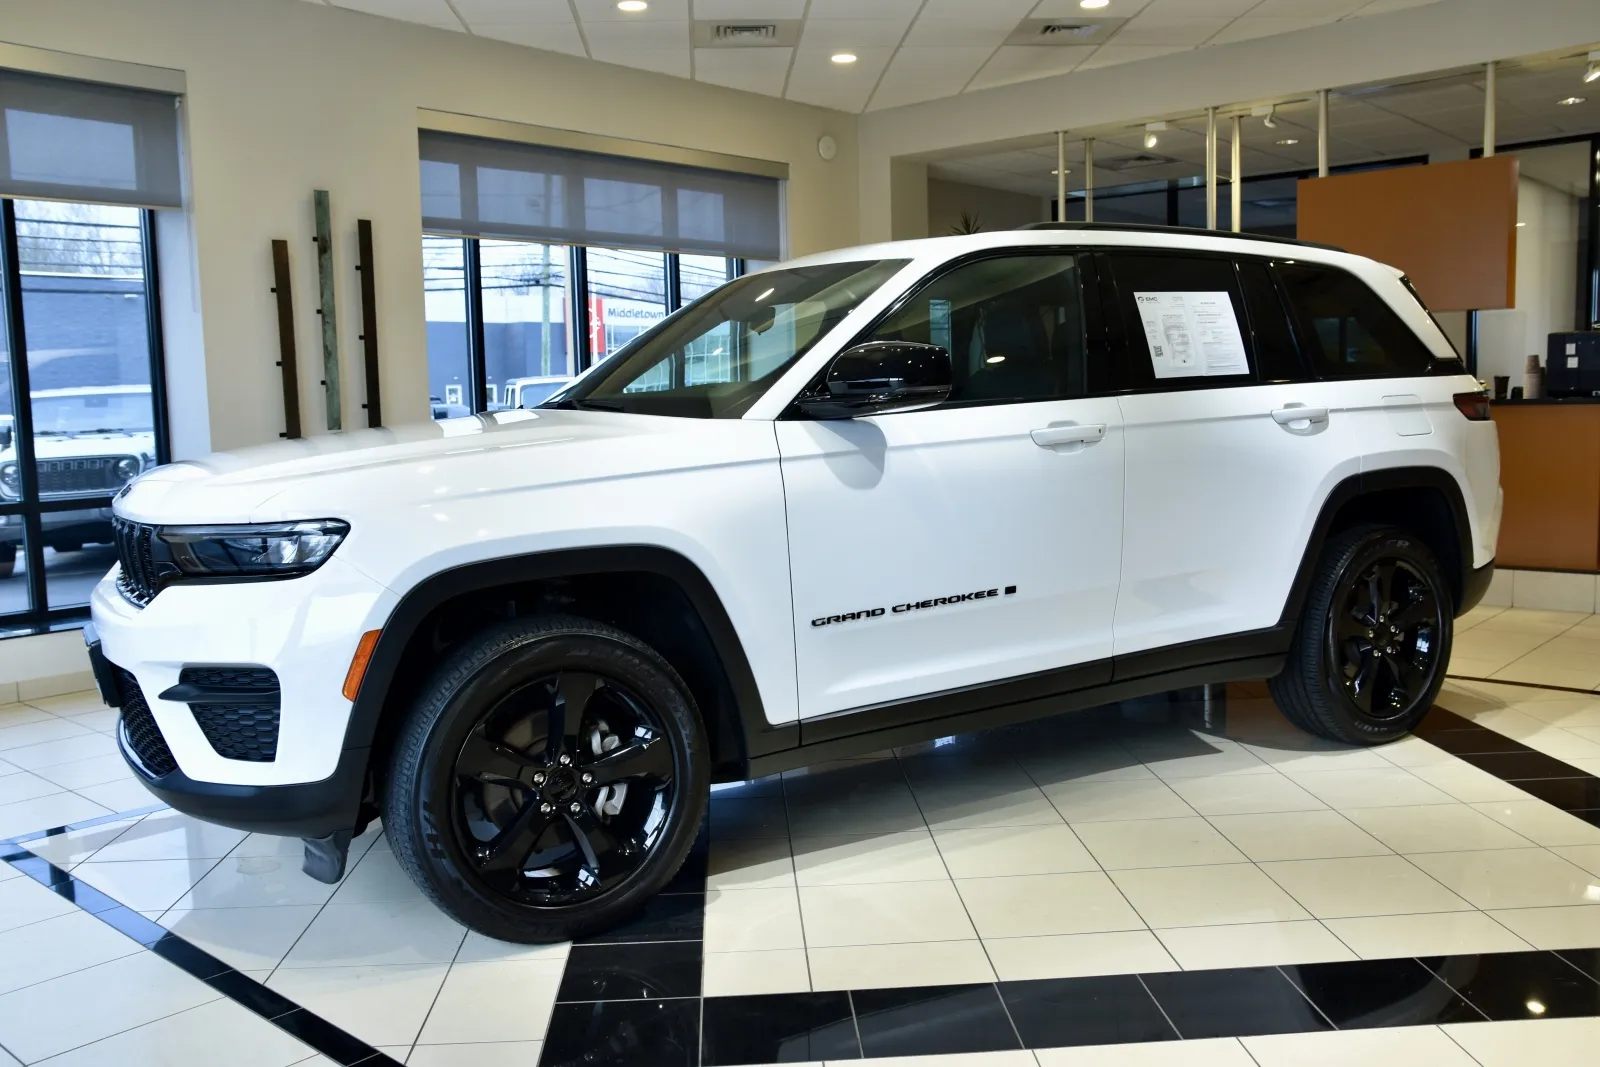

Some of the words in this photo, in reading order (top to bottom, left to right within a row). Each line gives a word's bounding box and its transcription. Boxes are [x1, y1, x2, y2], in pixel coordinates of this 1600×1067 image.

[608, 308, 664, 319] Middletown
[811, 607, 886, 627] GRAND
[891, 588, 999, 614] CHEROKEE
